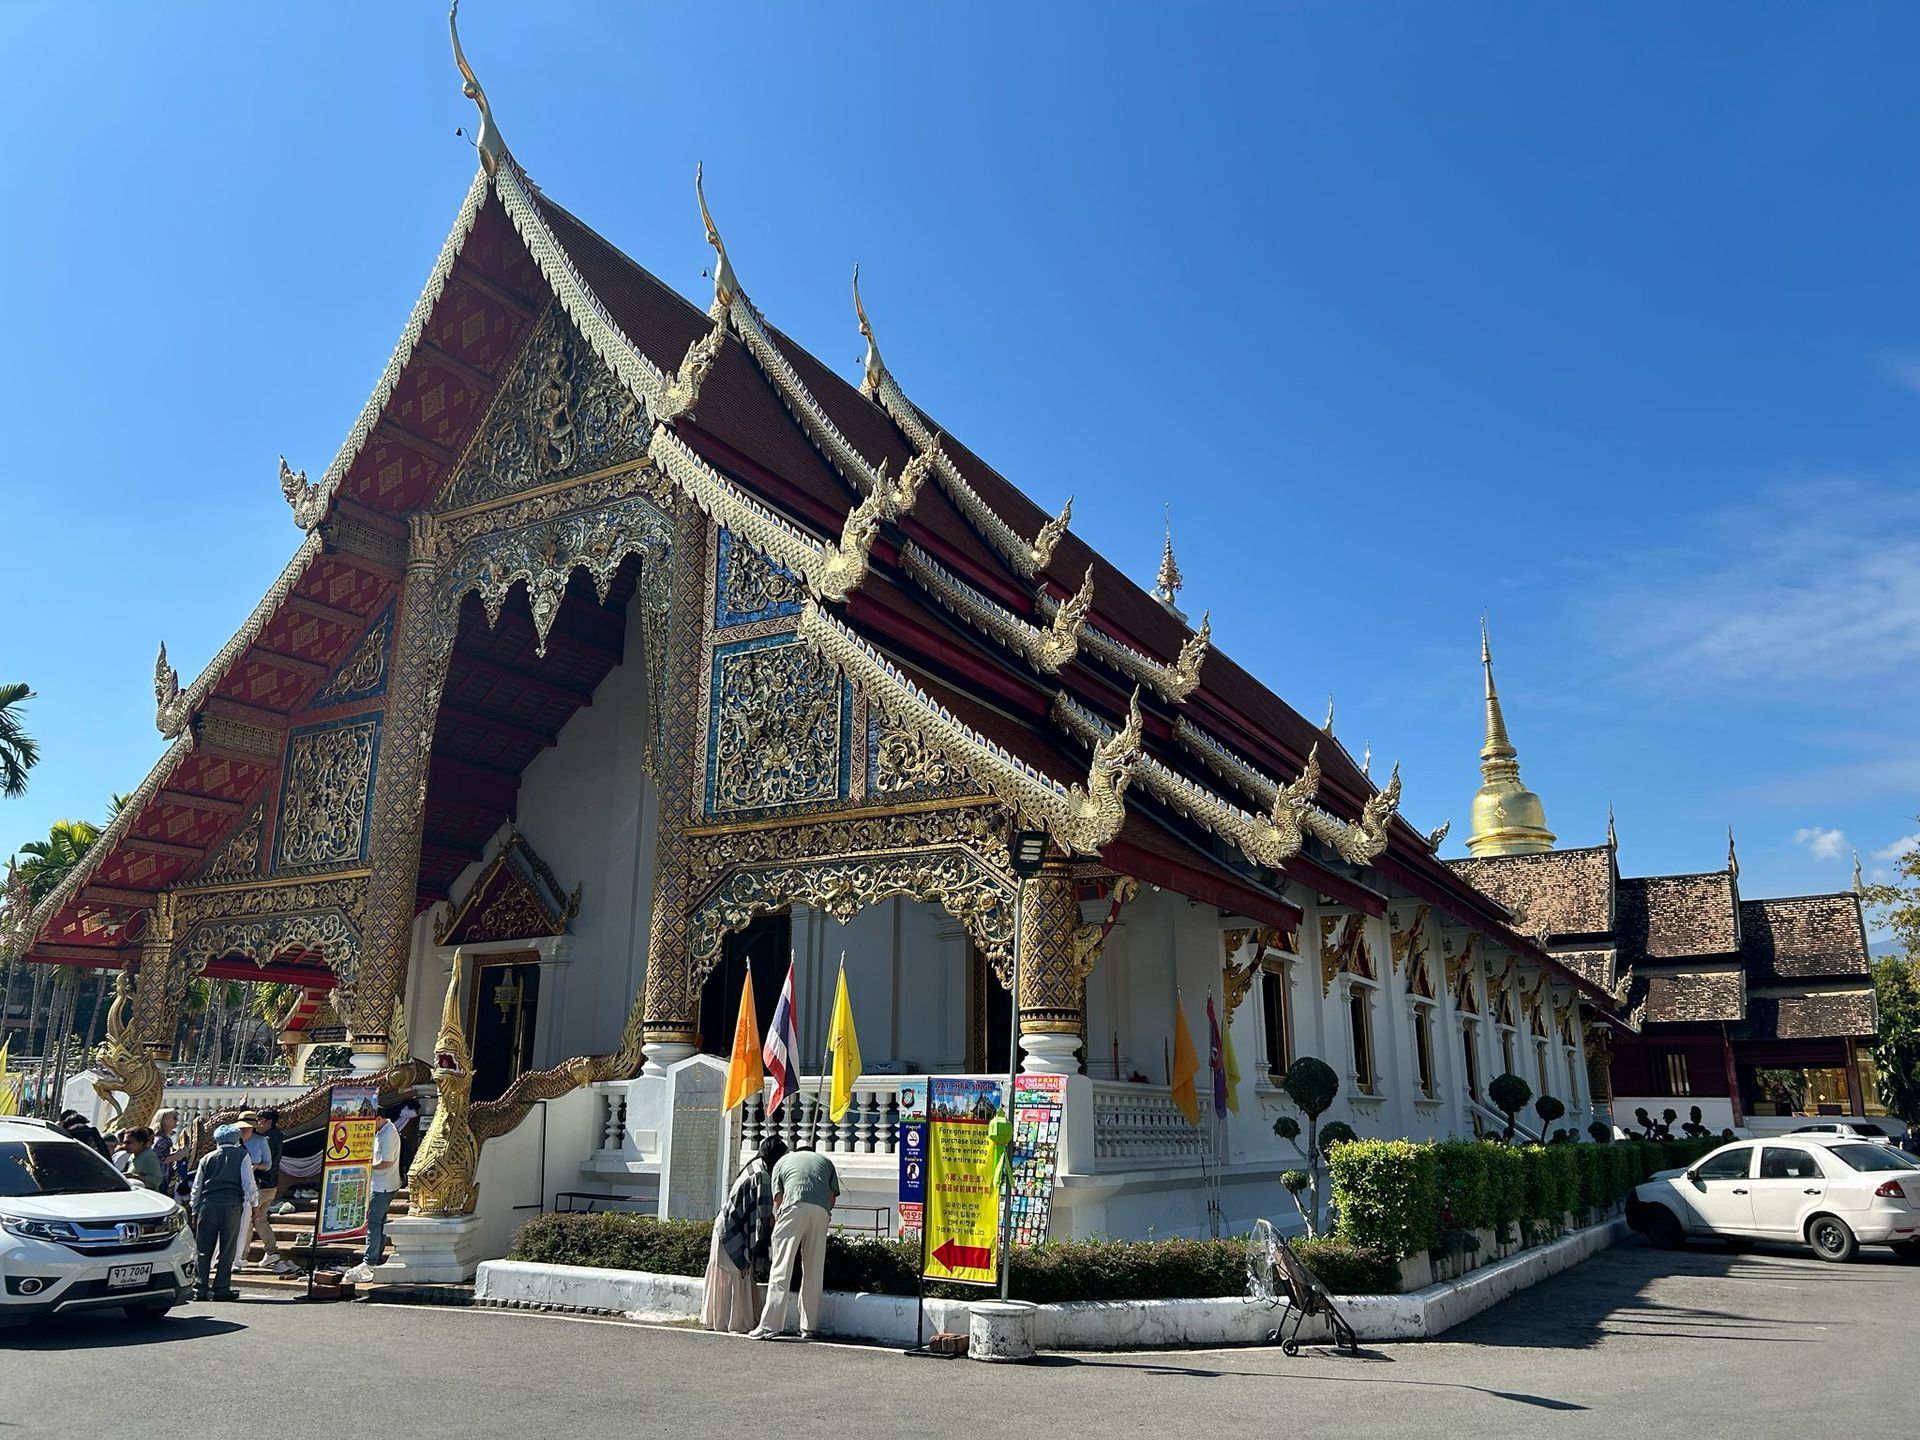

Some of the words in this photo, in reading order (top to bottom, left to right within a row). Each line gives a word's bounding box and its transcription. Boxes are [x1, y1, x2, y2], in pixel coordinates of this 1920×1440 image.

[354, 1123, 374, 1131] TICKET
[939, 1126, 971, 1136] Foreigners
[972, 1129, 989, 1138] pleas
[940, 1137, 968, 1145] purchase
[963, 1148, 988, 1157] entering
[129, 1265, 150, 1276] 7004
